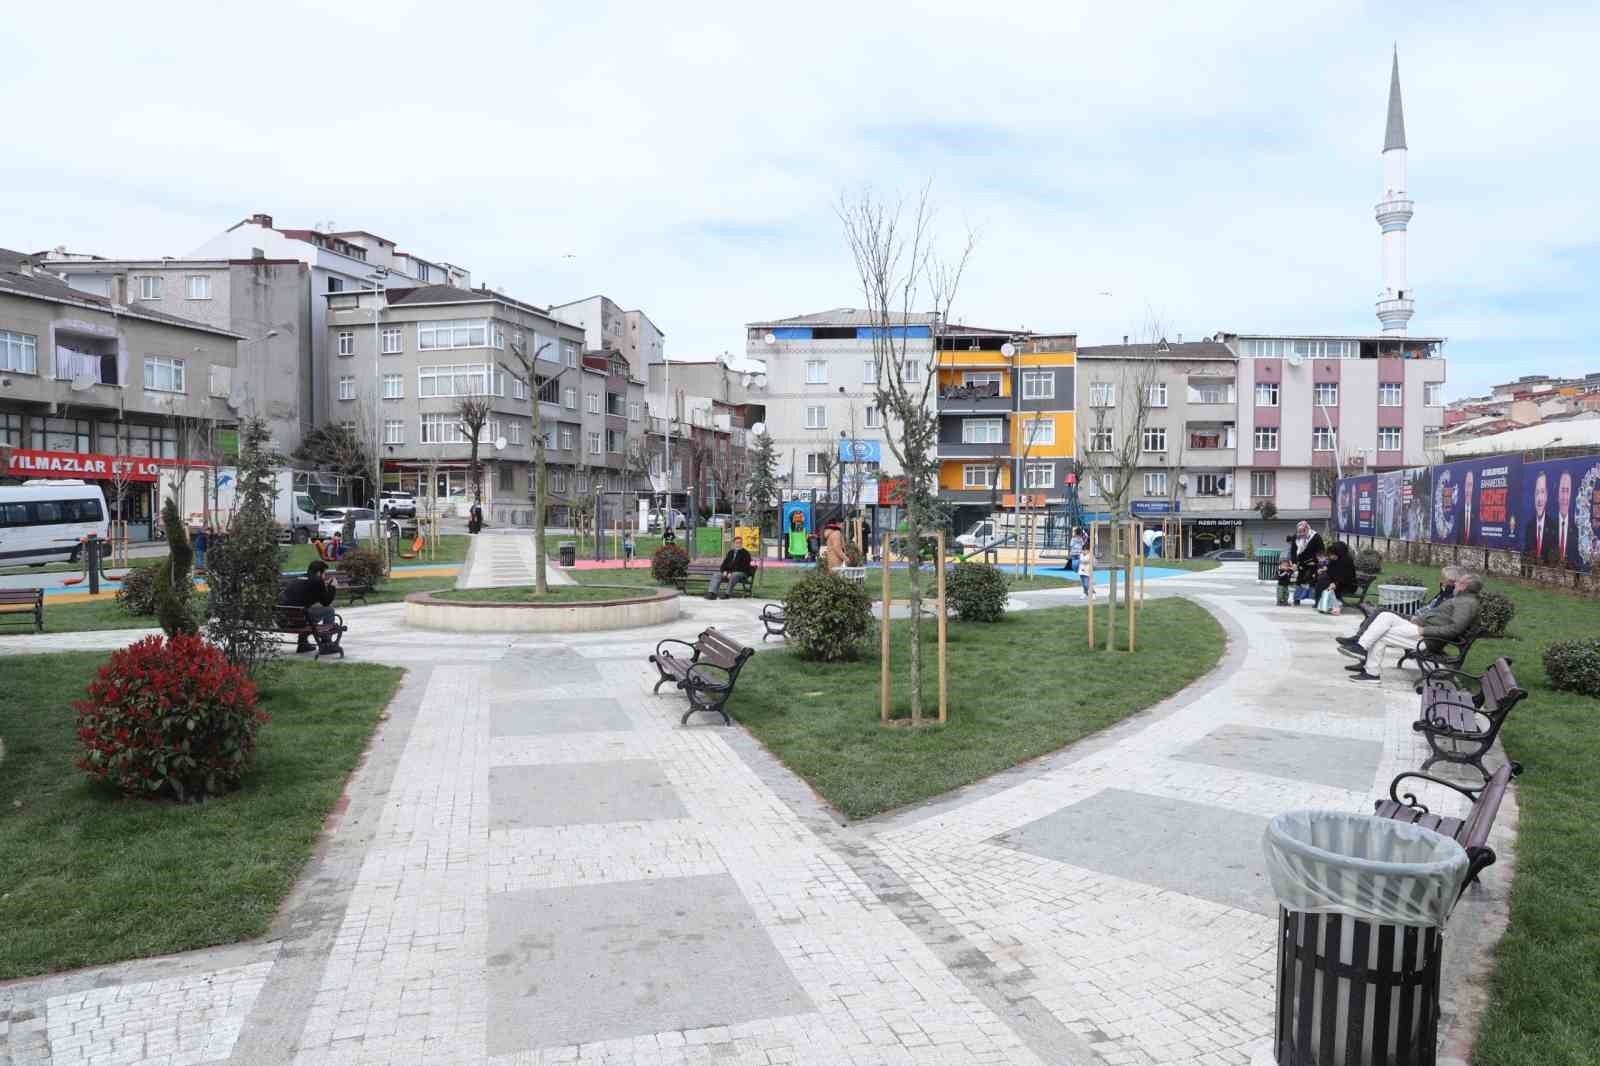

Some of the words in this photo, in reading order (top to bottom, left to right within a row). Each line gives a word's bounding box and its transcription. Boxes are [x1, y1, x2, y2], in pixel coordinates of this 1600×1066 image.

[8, 455, 106, 473] YILMAZLAR
[112, 460, 134, 474] ET
[138, 463, 159, 475] LO
